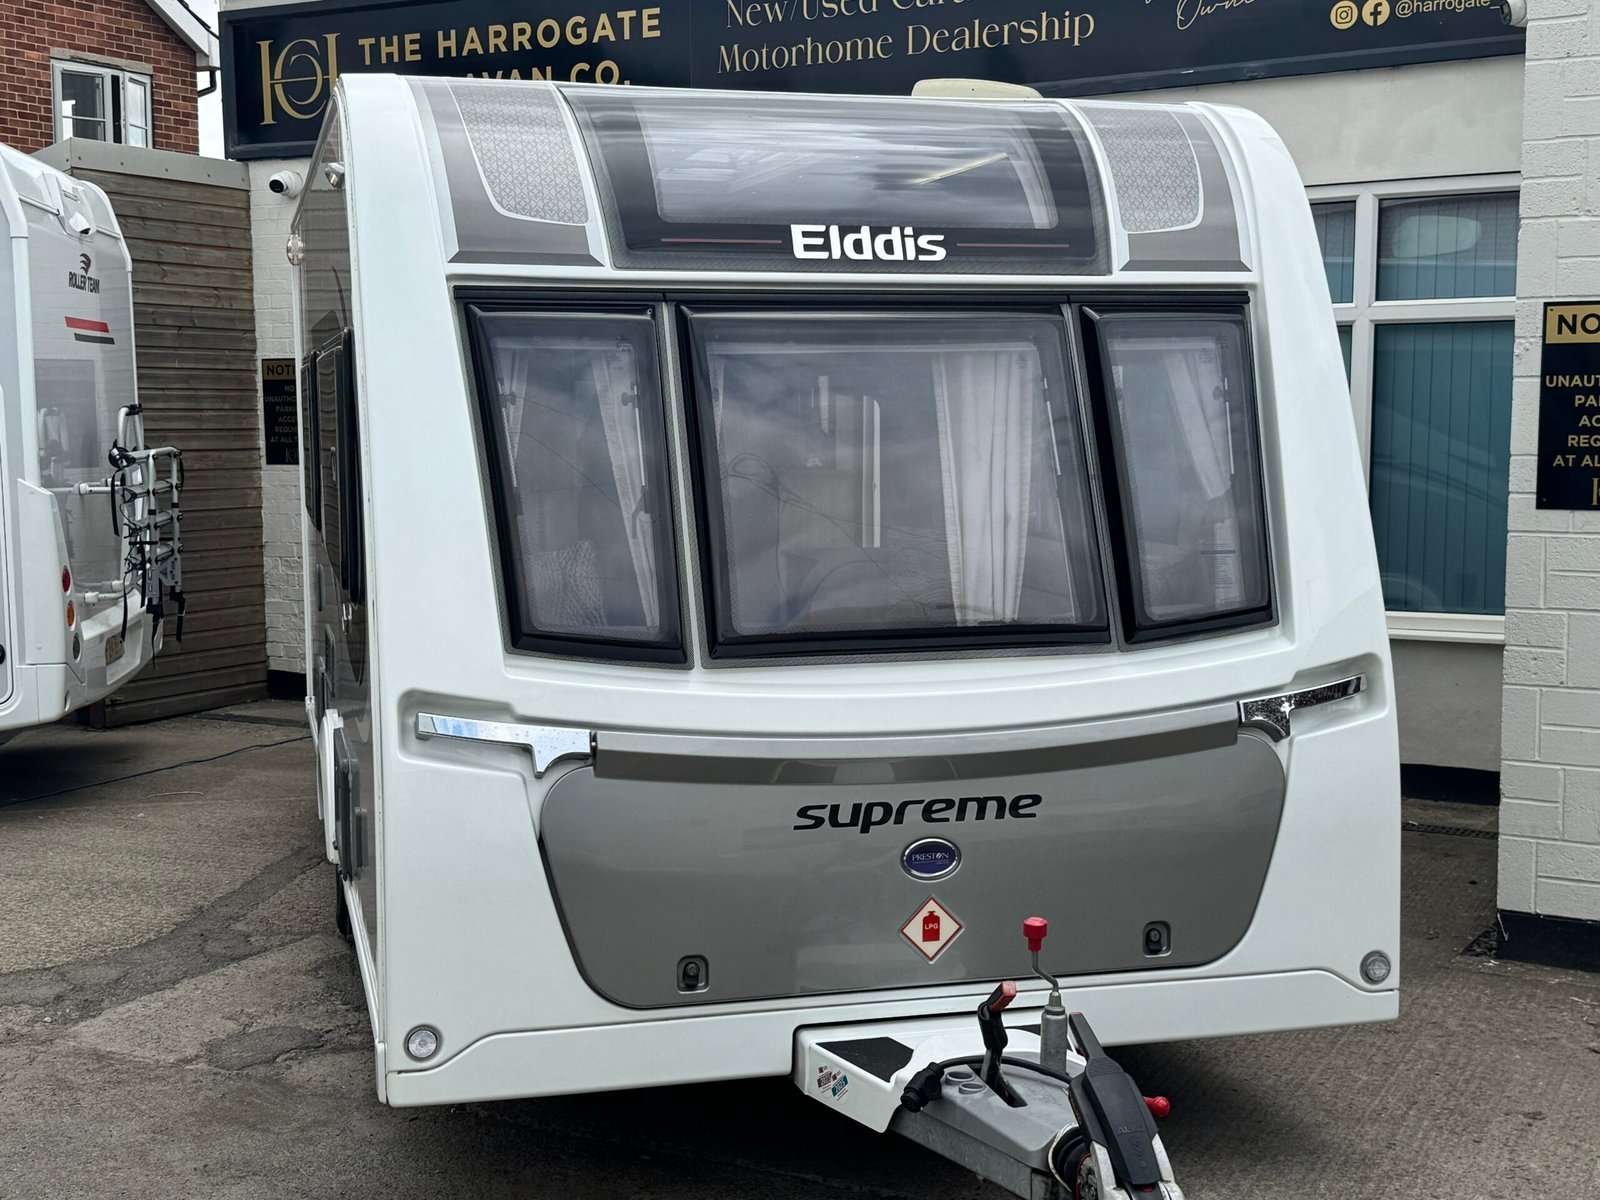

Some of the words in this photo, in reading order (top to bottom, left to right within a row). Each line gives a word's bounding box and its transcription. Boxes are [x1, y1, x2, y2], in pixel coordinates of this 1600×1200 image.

[358, 36, 422, 66] THE
[437, 7, 662, 57] HARROGATE
[717, 33, 893, 73] Motorhome
[907, 10, 1095, 56] Dealership
[790, 223, 947, 262] Elddis
[68, 271, 87, 292] ROLLER
[87, 276, 100, 294] TEAM
[1575, 395, 1600, 407] PA
[1553, 455, 1576, 467] AT
[793, 793, 1042, 834] supreme
[924, 922, 939, 930] LPG
